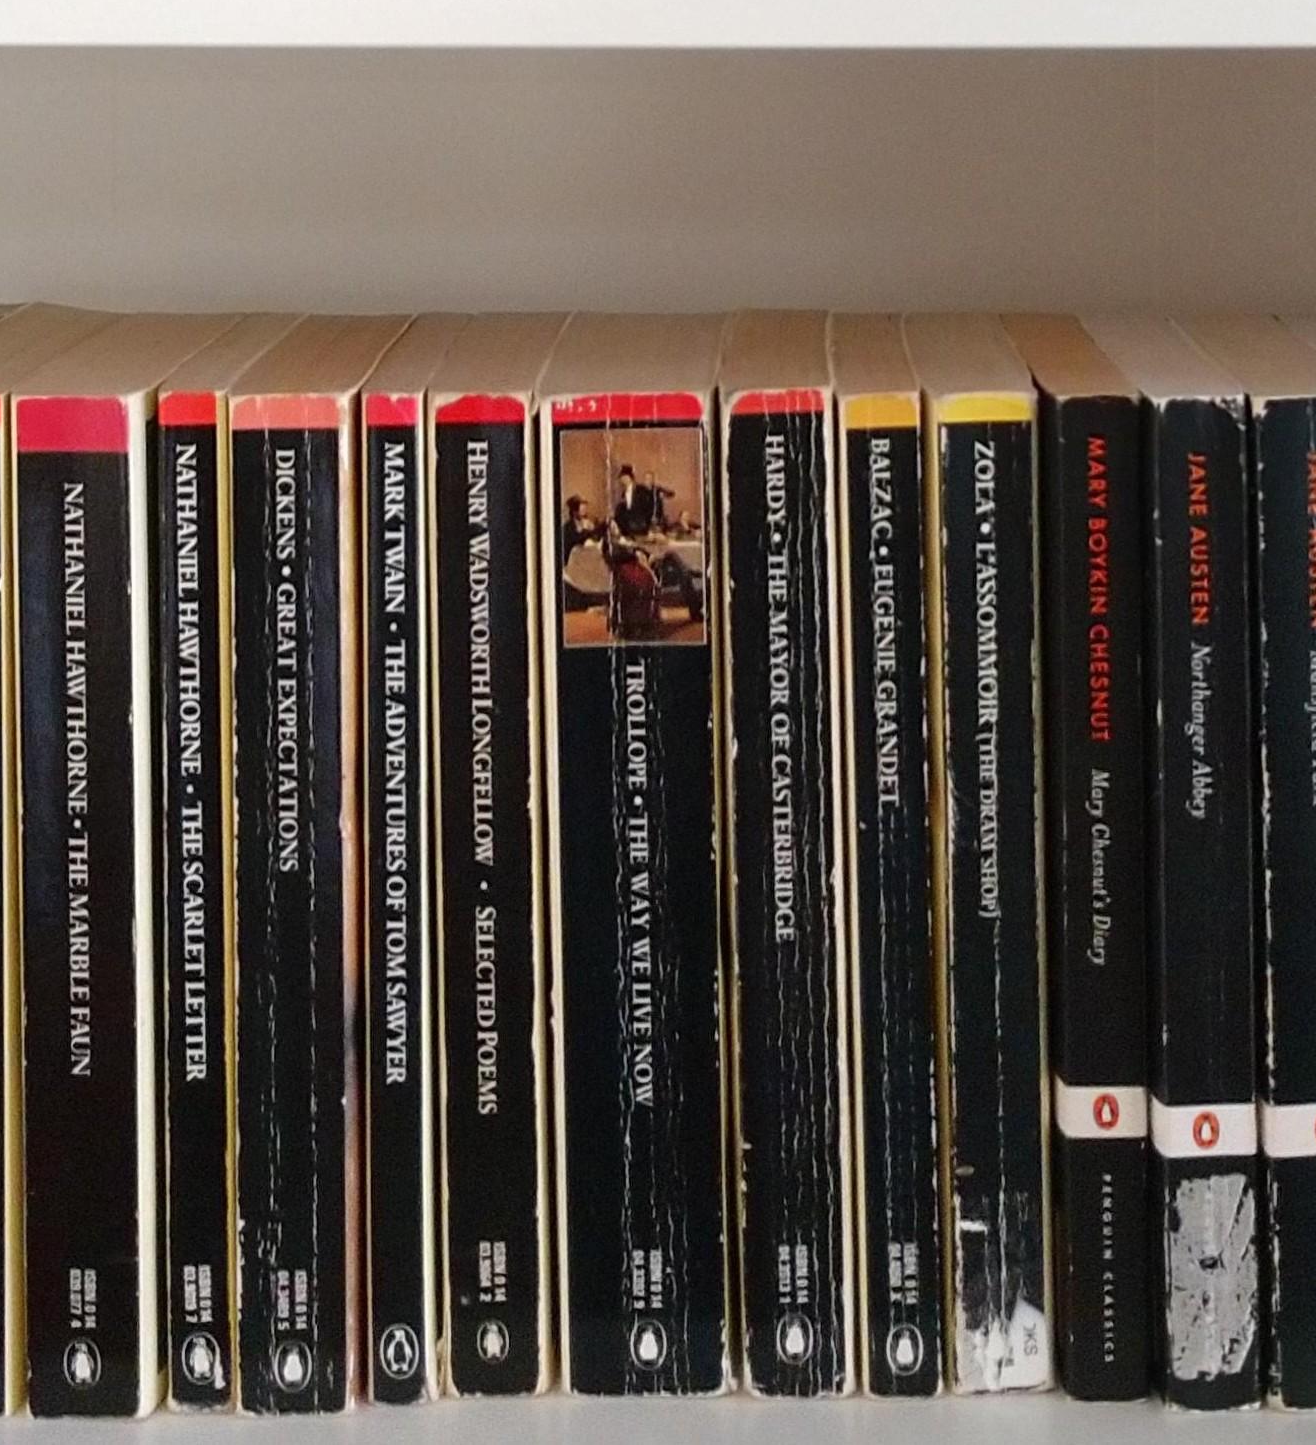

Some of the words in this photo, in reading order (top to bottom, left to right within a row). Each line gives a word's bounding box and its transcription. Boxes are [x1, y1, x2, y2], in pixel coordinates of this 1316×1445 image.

[275, 449, 297, 563] DICKENS
[1187, 452, 1207, 517] JANE
[276, 578, 298, 672] GREAT
[1189, 525, 1209, 626] AUSTEN
[1184, 641, 1214, 752] Northanger
[277, 677, 300, 873] EXPECTATIONS
[1185, 755, 1215, 820] Abbey
